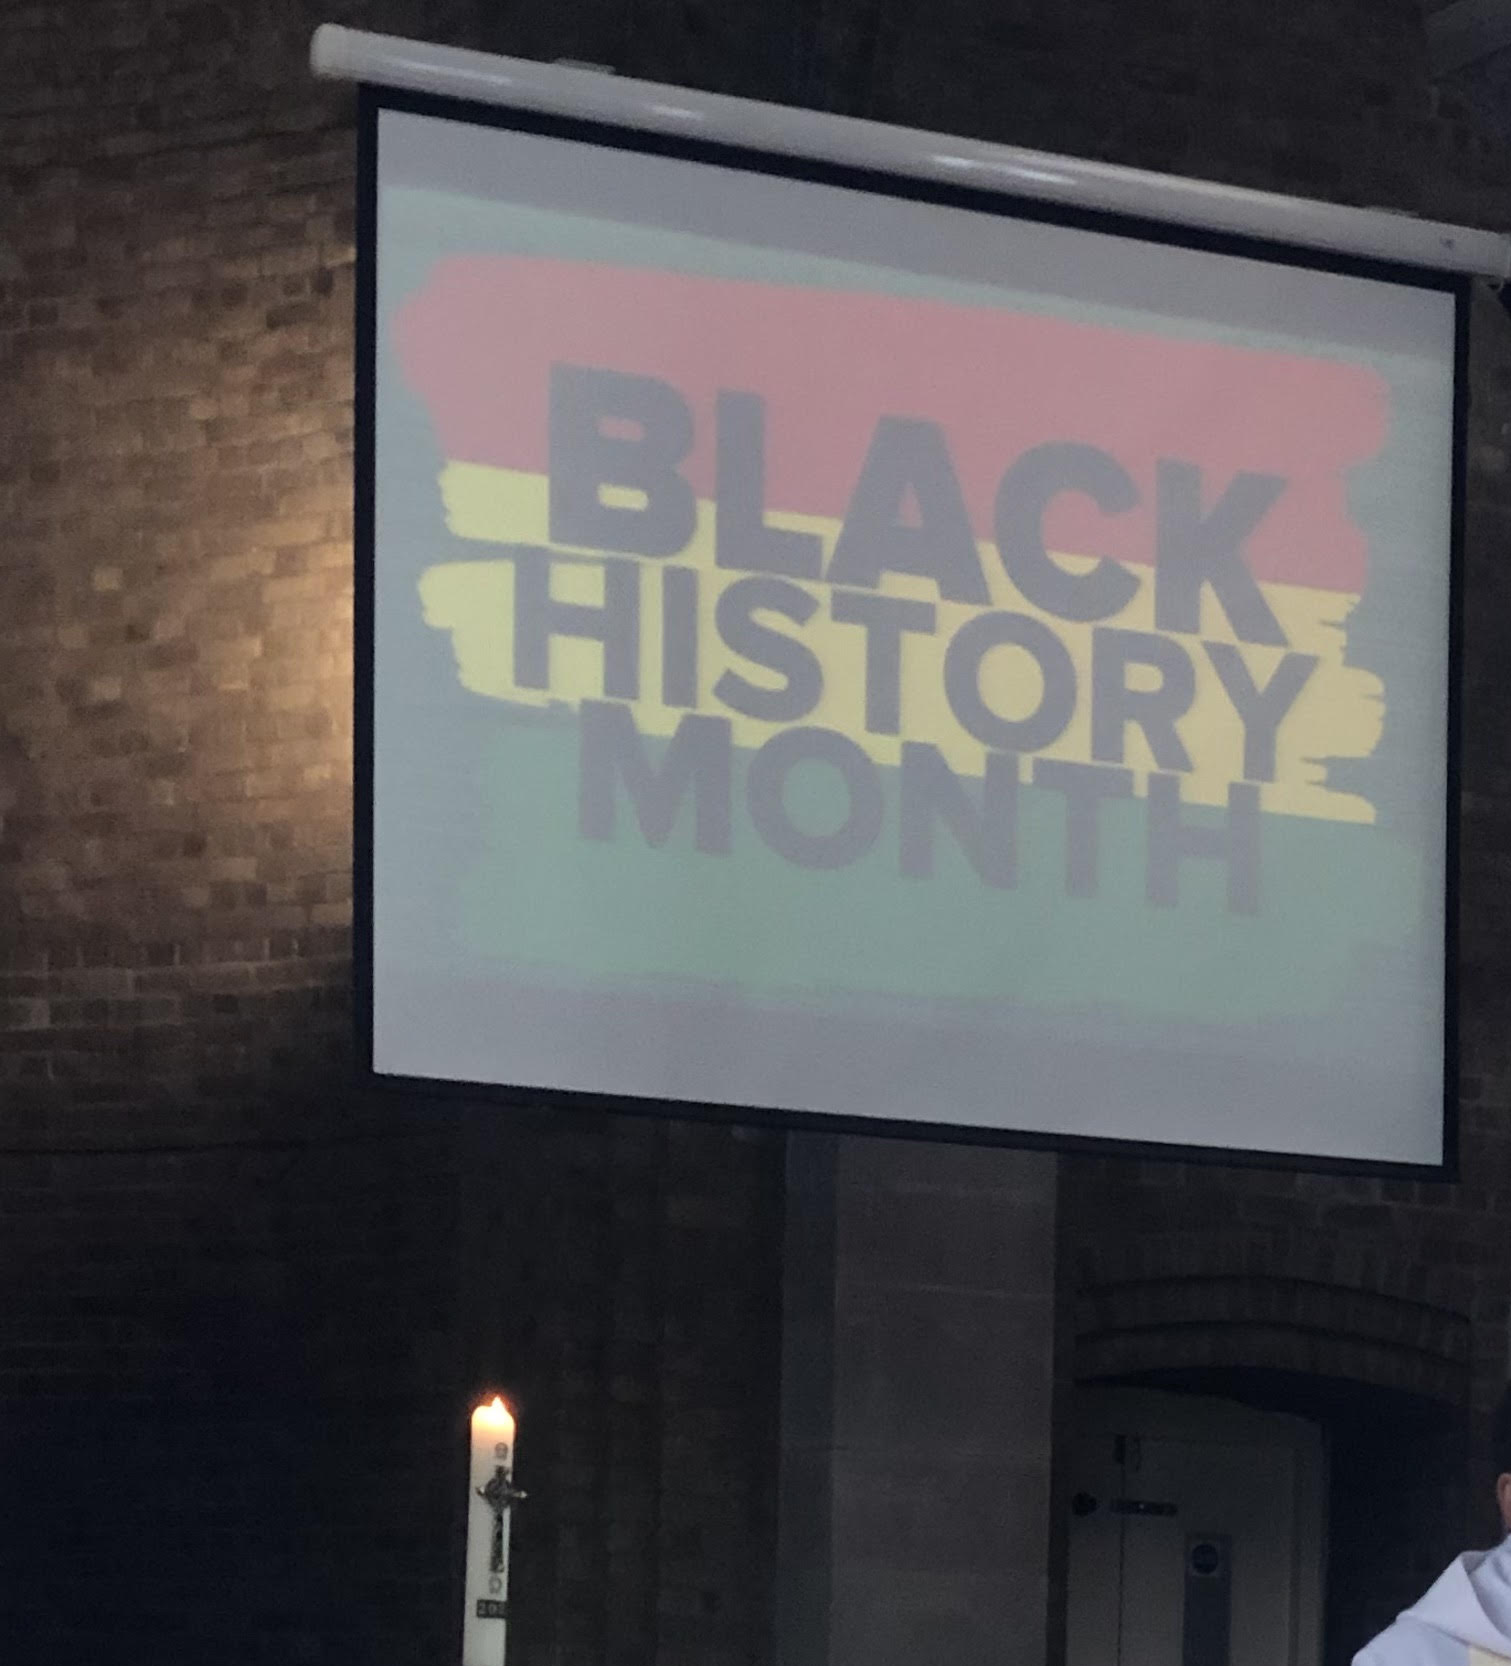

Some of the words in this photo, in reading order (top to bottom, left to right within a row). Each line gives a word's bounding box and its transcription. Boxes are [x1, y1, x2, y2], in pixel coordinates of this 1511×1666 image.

[548, 361, 1290, 648] BLACK
[513, 545, 1321, 784] HISTORY
[577, 698, 1261, 916] MONTH
[478, 1601, 506, 1617] 202
